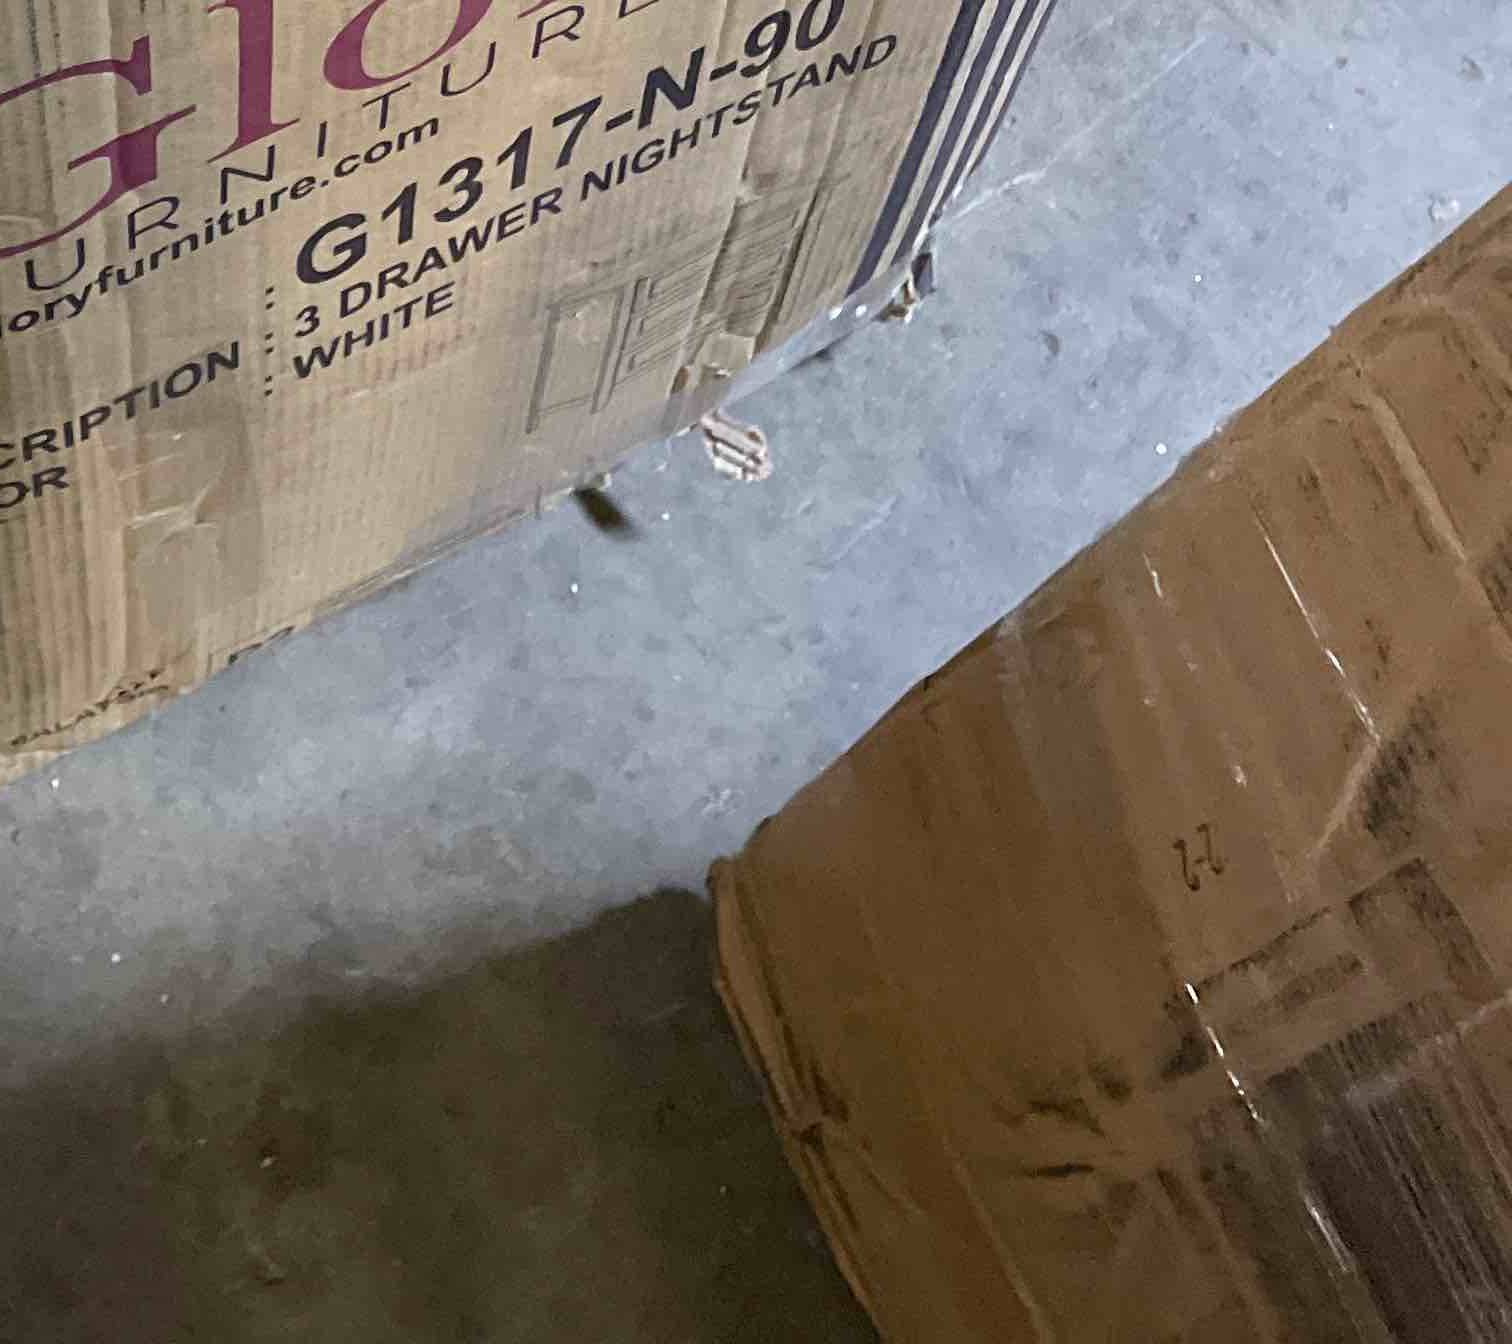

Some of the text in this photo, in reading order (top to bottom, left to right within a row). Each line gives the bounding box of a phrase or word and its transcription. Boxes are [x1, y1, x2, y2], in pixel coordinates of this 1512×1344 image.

[294, 303, 321, 339] 3
[338, 185, 564, 320] DRAWER
[580, 33, 899, 203] NIGHTSTAND
[292, 280, 456, 380] WHITE
